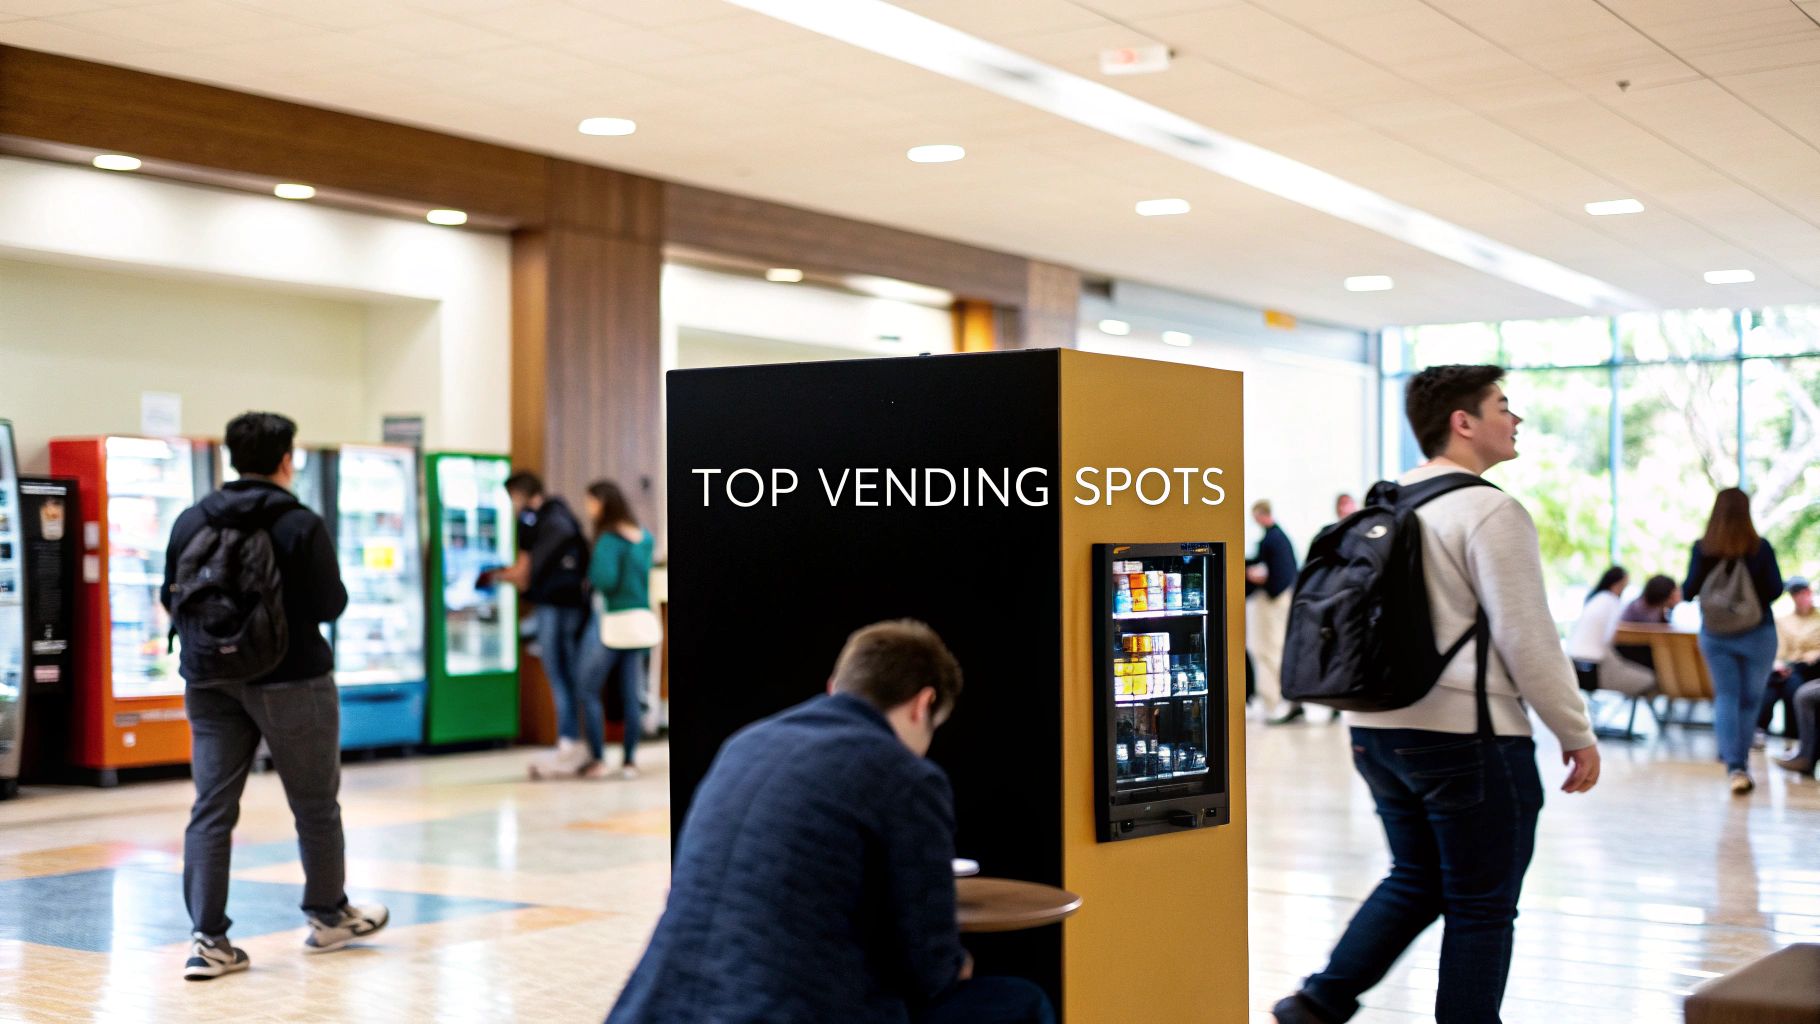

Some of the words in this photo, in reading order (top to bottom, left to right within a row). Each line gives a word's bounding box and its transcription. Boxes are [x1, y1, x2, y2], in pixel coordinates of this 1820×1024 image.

[691, 468, 799, 507] TOP
[817, 467, 1049, 507] VENDING
[1074, 466, 1226, 506] SPOTS
